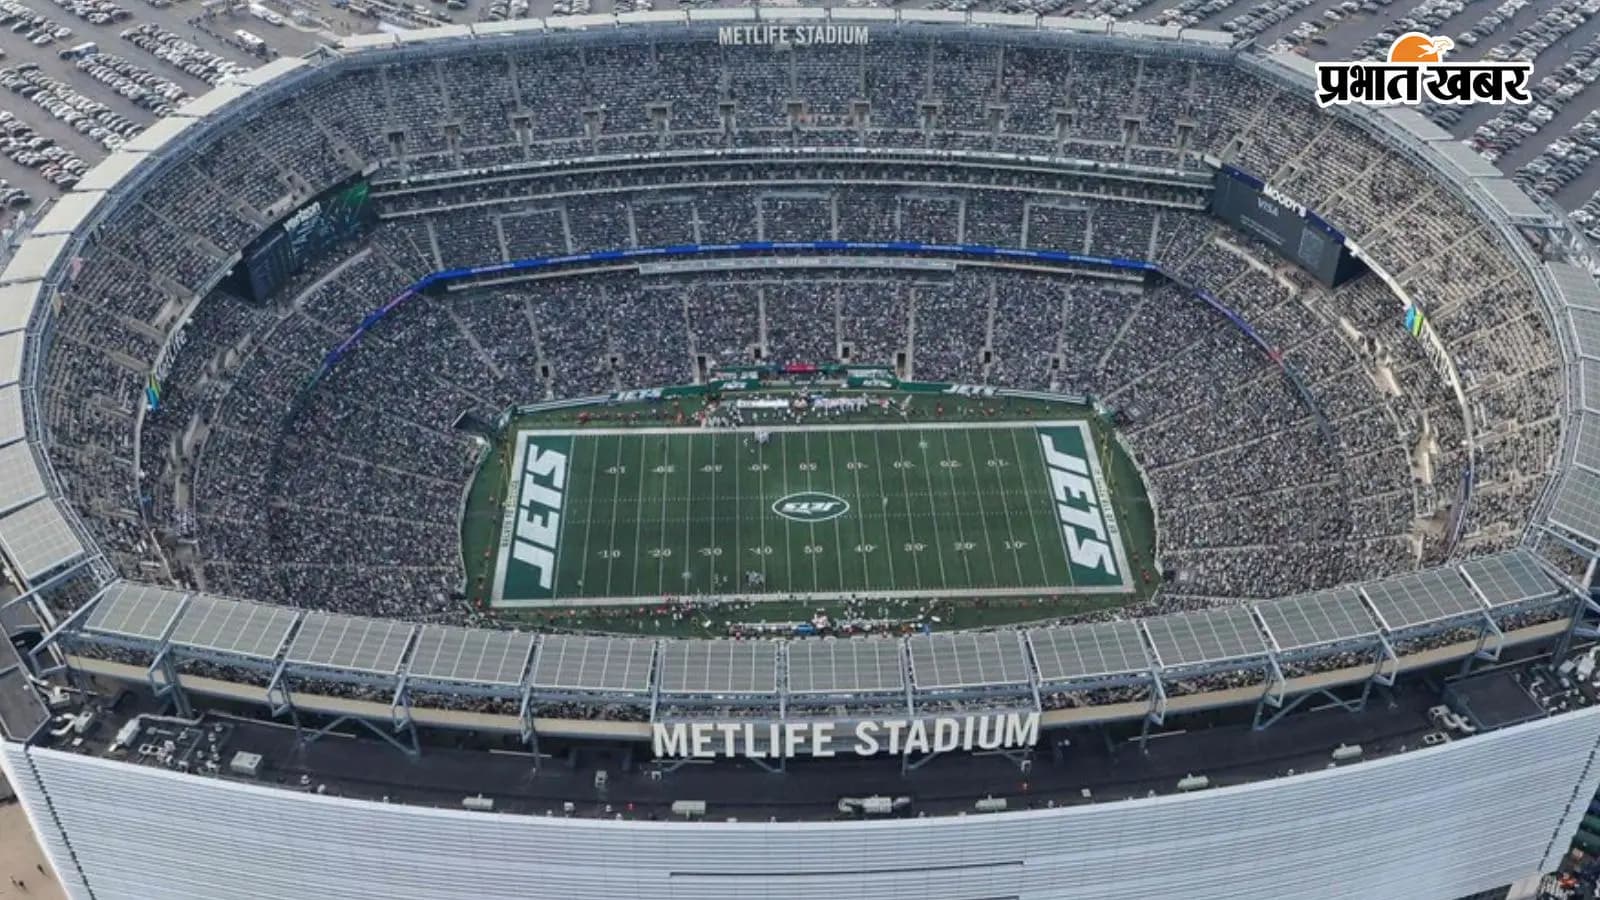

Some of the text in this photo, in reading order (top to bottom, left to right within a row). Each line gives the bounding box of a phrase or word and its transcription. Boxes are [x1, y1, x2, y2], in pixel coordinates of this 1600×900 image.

[719, 25, 869, 45] METLIFE STADIUM
[1040, 433, 1117, 576] JETS
[513, 443, 567, 589] JETS
[804, 544, 823, 553] 50
[854, 544, 873, 552] 40
[1005, 541, 1022, 549] 10
[603, 549, 620, 558] 10
[652, 548, 671, 557] 20
[703, 547, 722, 556] 30
[652, 712, 1040, 758] METLIFE STADIUM
